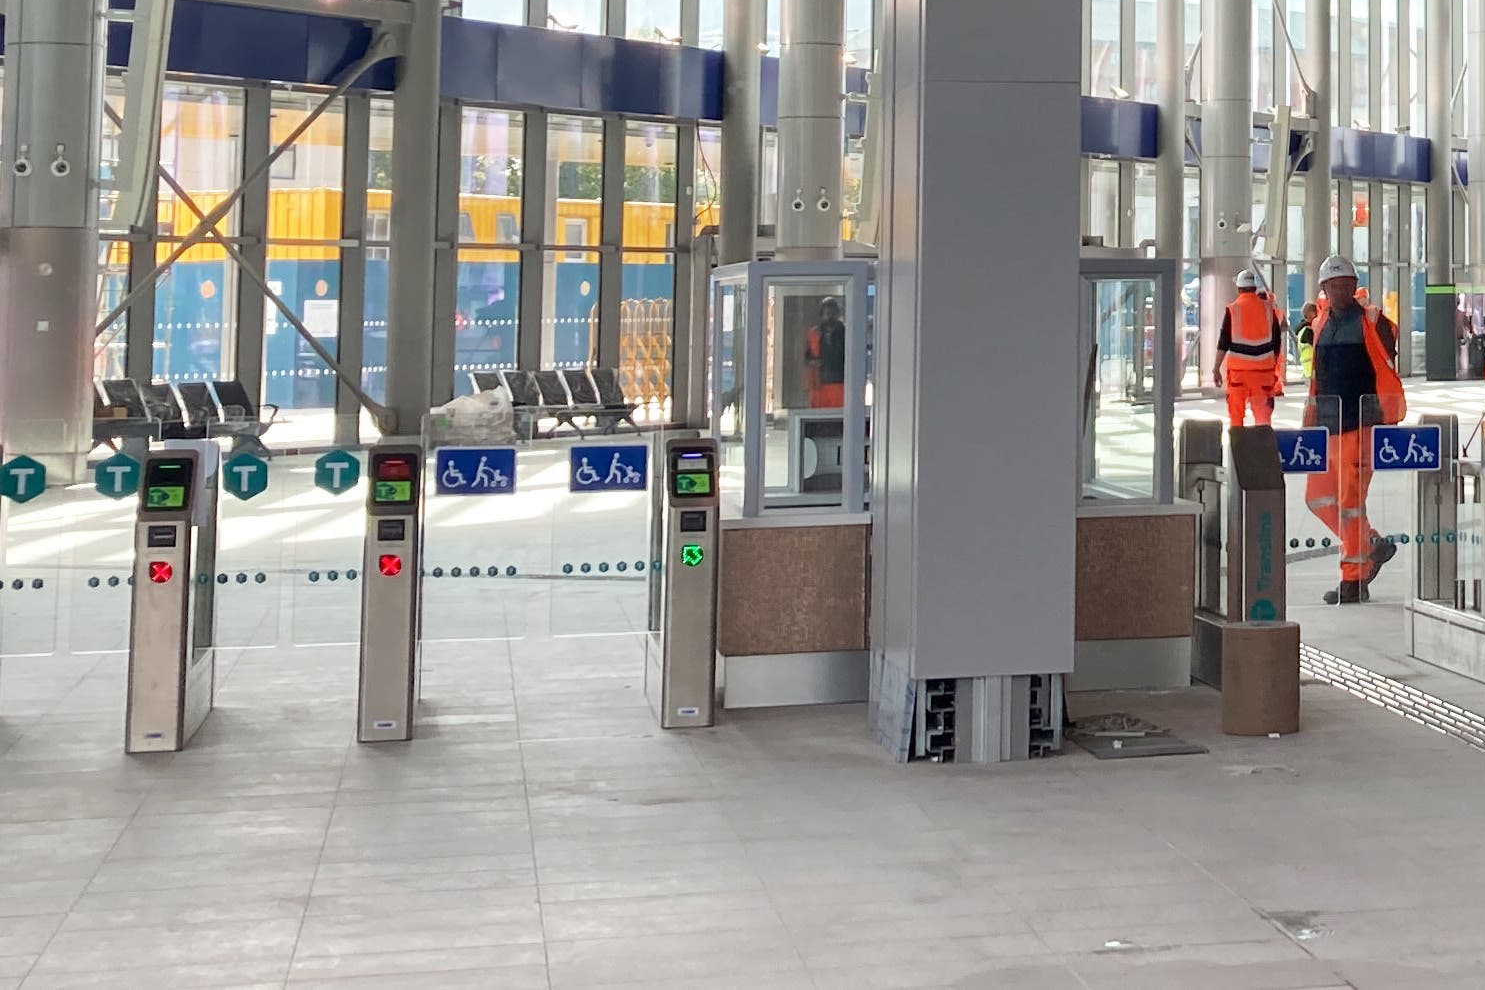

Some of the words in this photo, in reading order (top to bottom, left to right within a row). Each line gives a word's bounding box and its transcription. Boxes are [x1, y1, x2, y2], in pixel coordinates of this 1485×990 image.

[10, 468, 34, 495] T
[106, 466, 131, 492] T
[232, 465, 257, 492] T
[325, 462, 349, 488] T
